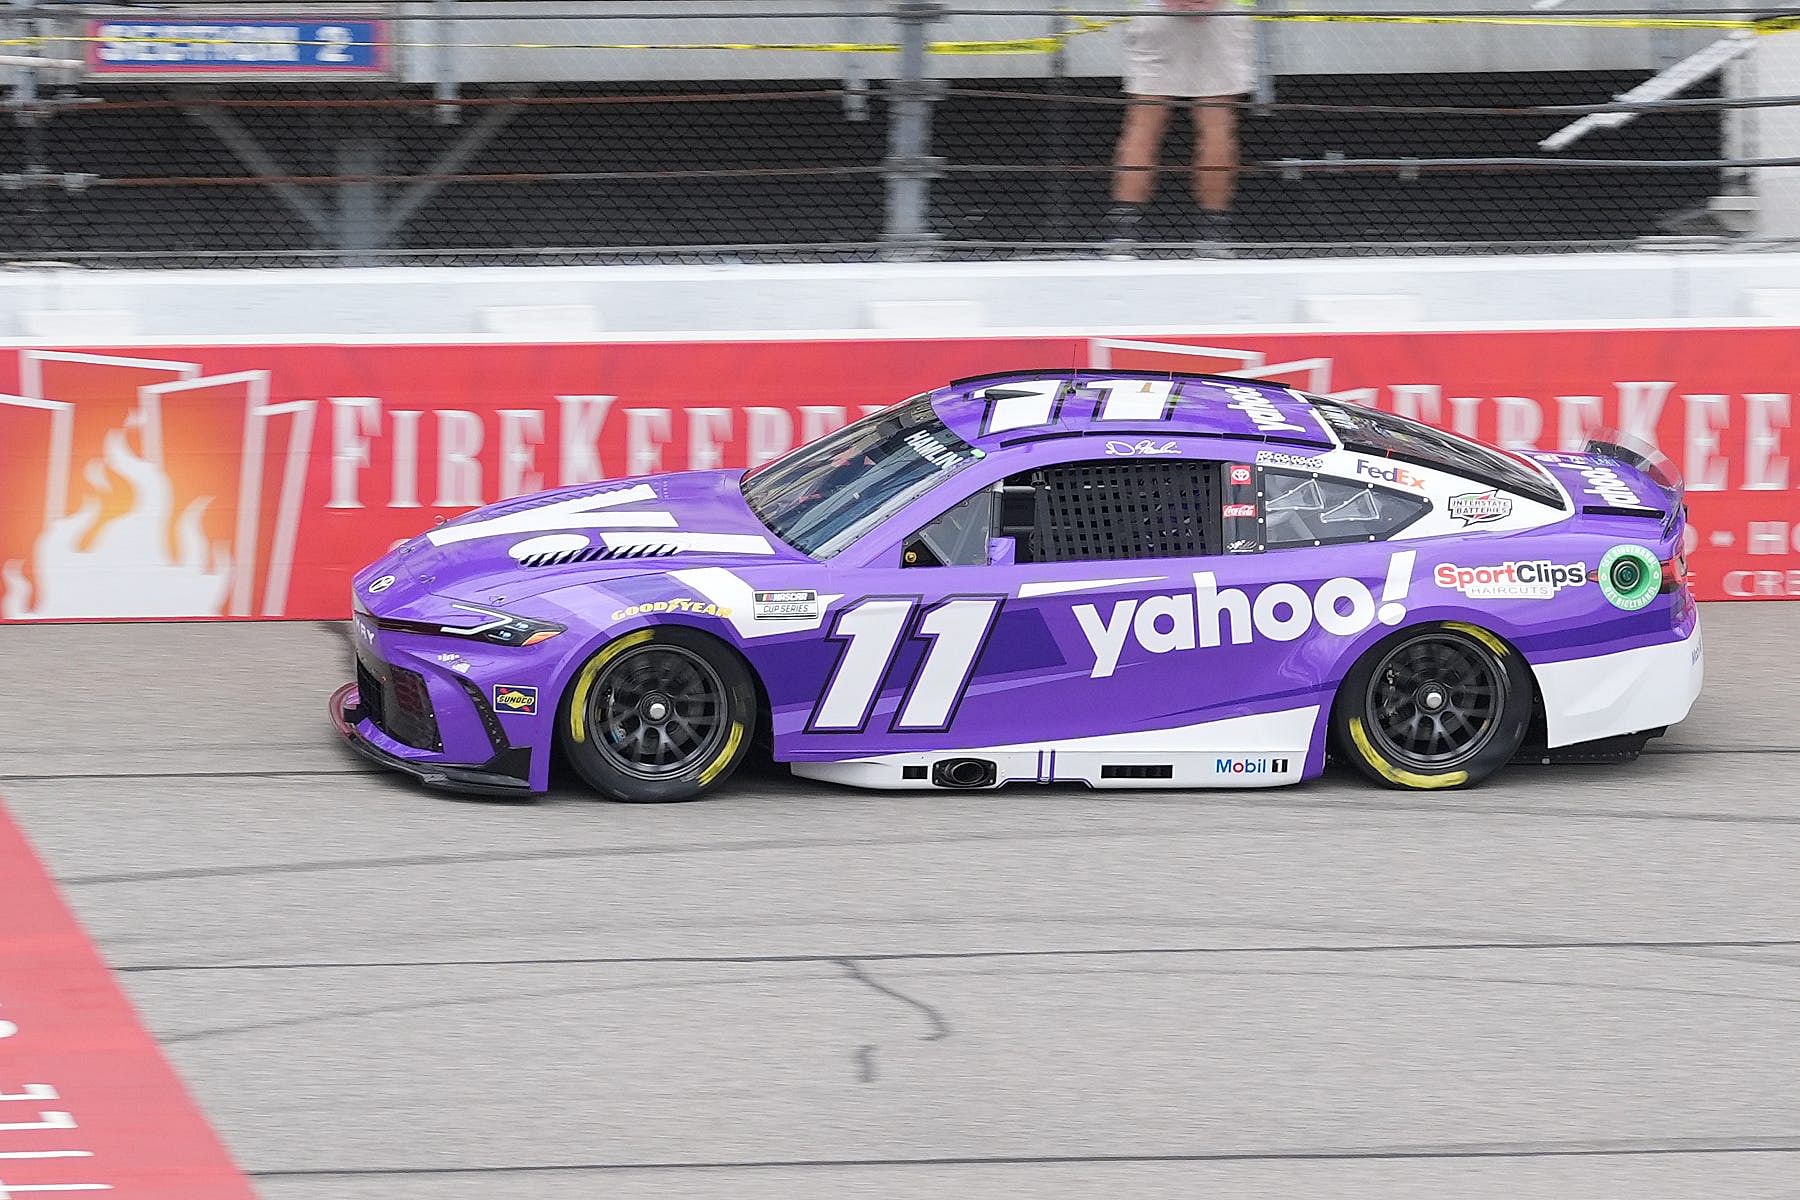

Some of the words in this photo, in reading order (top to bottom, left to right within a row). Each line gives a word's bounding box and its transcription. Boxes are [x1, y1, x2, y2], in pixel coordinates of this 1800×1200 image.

[315, 26, 353, 61] 2
[968, 379, 1178, 434] 11
[324, 395, 888, 508] FIREKEEP
[903, 429, 964, 470] HAMLIN
[1386, 381, 1800, 492] REKEE
[1356, 458, 1426, 490] FedEx
[1452, 500, 1508, 508] INTERSTATE
[1747, 521, 1800, 554] H
[1437, 563, 1584, 588] SportClips
[1470, 585, 1549, 595] HAIRCUTS
[611, 598, 733, 621] GOODYEAR
[763, 604, 780, 613] CUP
[780, 604, 809, 613] SERIES
[773, 592, 808, 601] NASCAR
[1073, 550, 1417, 678] yahoo!
[808, 596, 1004, 730] 11
[498, 695, 534, 704] SUNOCO
[1216, 759, 1266, 773] Mobil
[1272, 759, 1288, 773] 1
